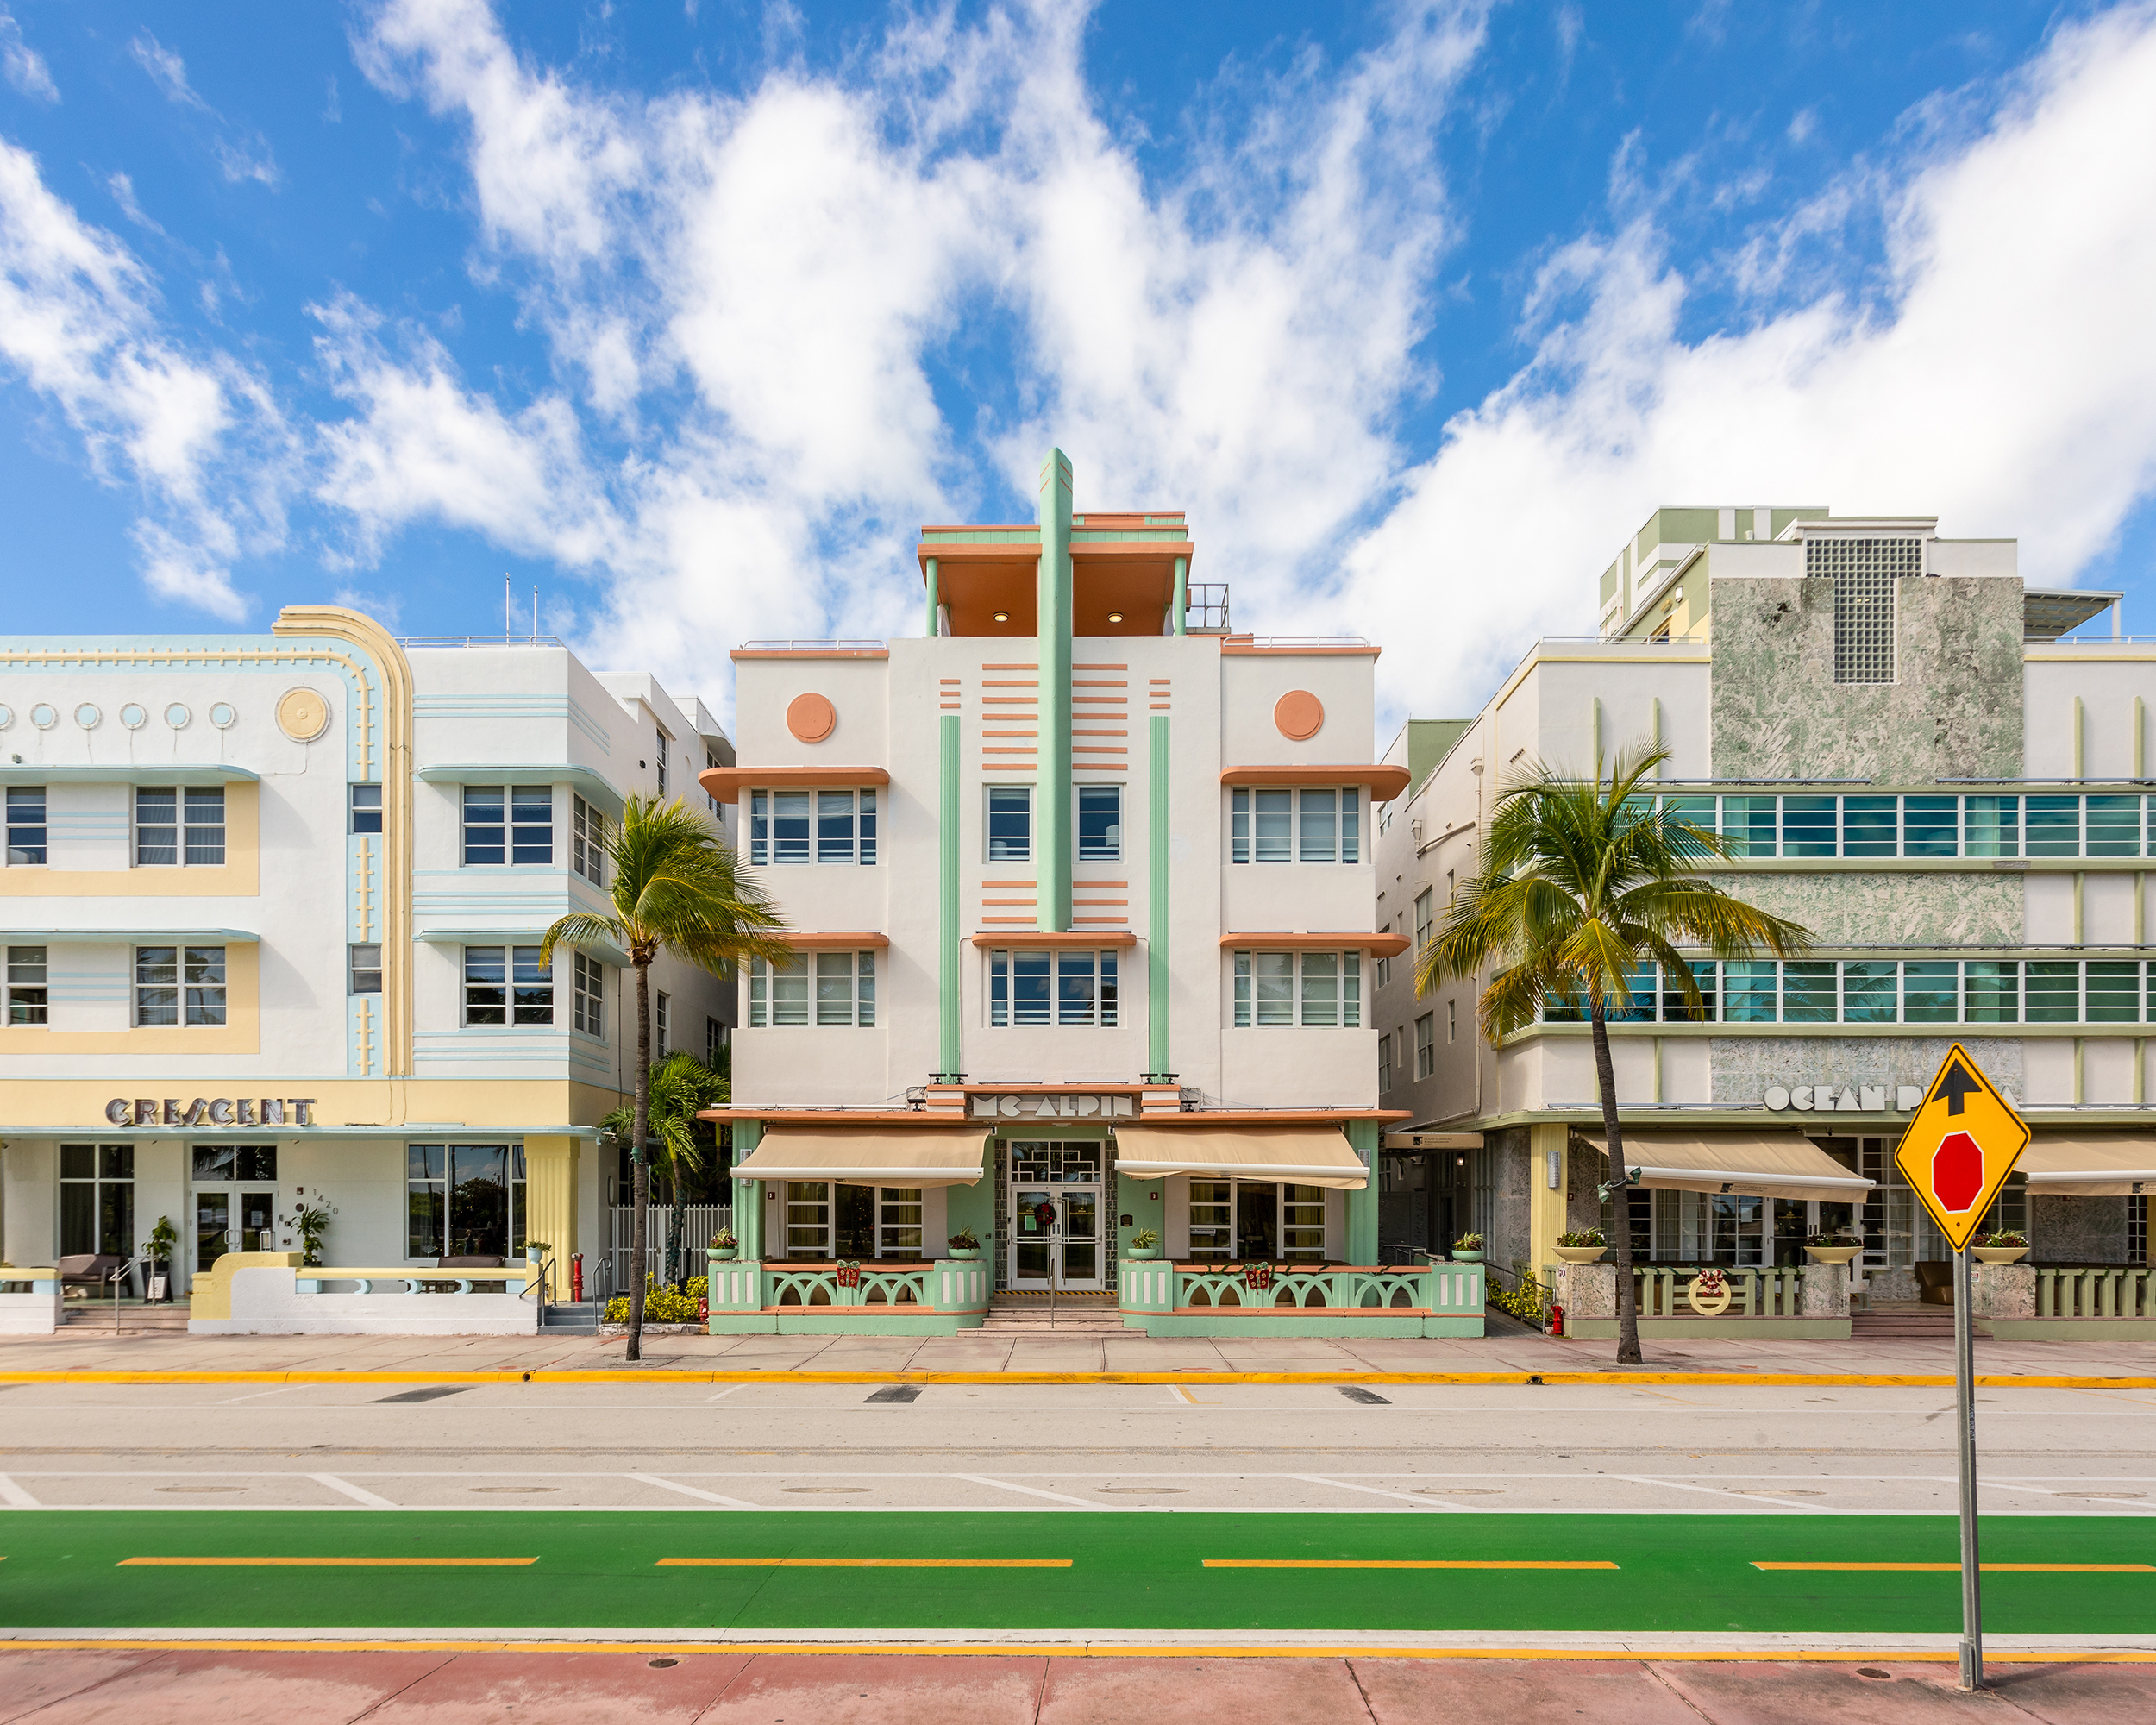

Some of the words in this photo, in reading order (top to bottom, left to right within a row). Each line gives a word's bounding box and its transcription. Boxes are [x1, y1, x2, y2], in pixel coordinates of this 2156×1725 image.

[973, 1095, 1021, 1117] MC
[1035, 1095, 1133, 1117] ALPIN
[1764, 1085, 1885, 1111] OCEAN
[105, 1098, 317, 1126] CRESCENT
[313, 1189, 339, 1214] 1420
